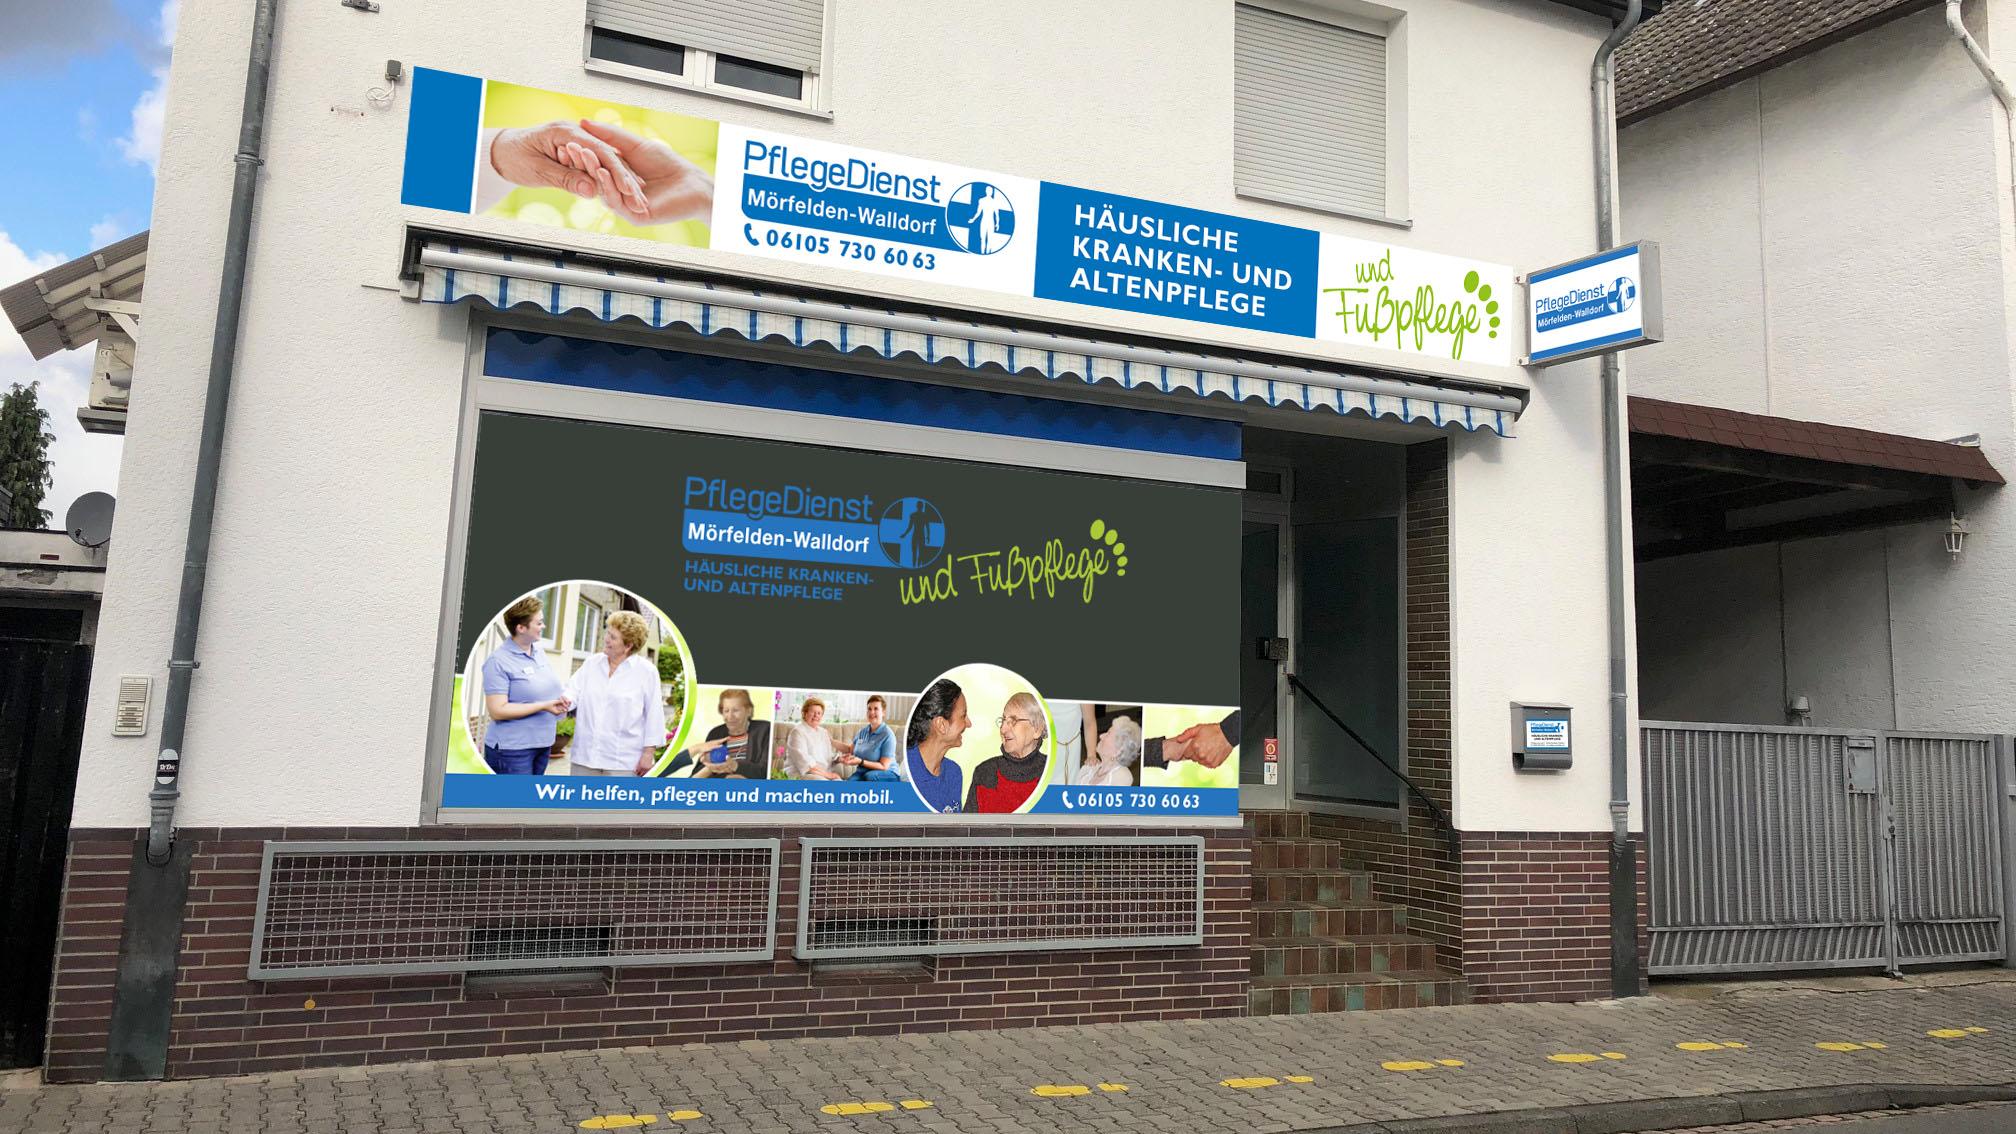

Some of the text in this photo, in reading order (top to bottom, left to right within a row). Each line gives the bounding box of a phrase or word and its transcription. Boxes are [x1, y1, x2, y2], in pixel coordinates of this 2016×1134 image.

[744, 140, 940, 203] PflegeDienst
[748, 188, 936, 235] Mörfelden-Walldorf
[1074, 203, 1239, 253] HÄUSLICHE
[766, 229, 830, 255] 06105
[839, 240, 875, 262] 730
[1073, 236, 1292, 291] KRANKEN- UND
[1355, 248, 1395, 284] und
[1070, 268, 1266, 317] ALTENPFLEGE
[1536, 283, 1605, 314] PflegeDienst
[1323, 284, 1481, 361] Fußpflege
[1537, 303, 1604, 328] Mörfelden-Walldorf
[684, 476, 874, 522] PflegeDienst
[688, 522, 870, 553] Mörfelden-Walldorf
[683, 578, 843, 601] UND ALTENPFLEGE
[685, 559, 874, 585] HÄUSLICHE KRANKEN-
[900, 538, 1109, 605] und Fußpflege
[535, 783, 894, 806] Wir helfen, pflegen und machen mobil.
[1078, 792, 1123, 807] 06105
[1130, 793, 1156, 808] 730
